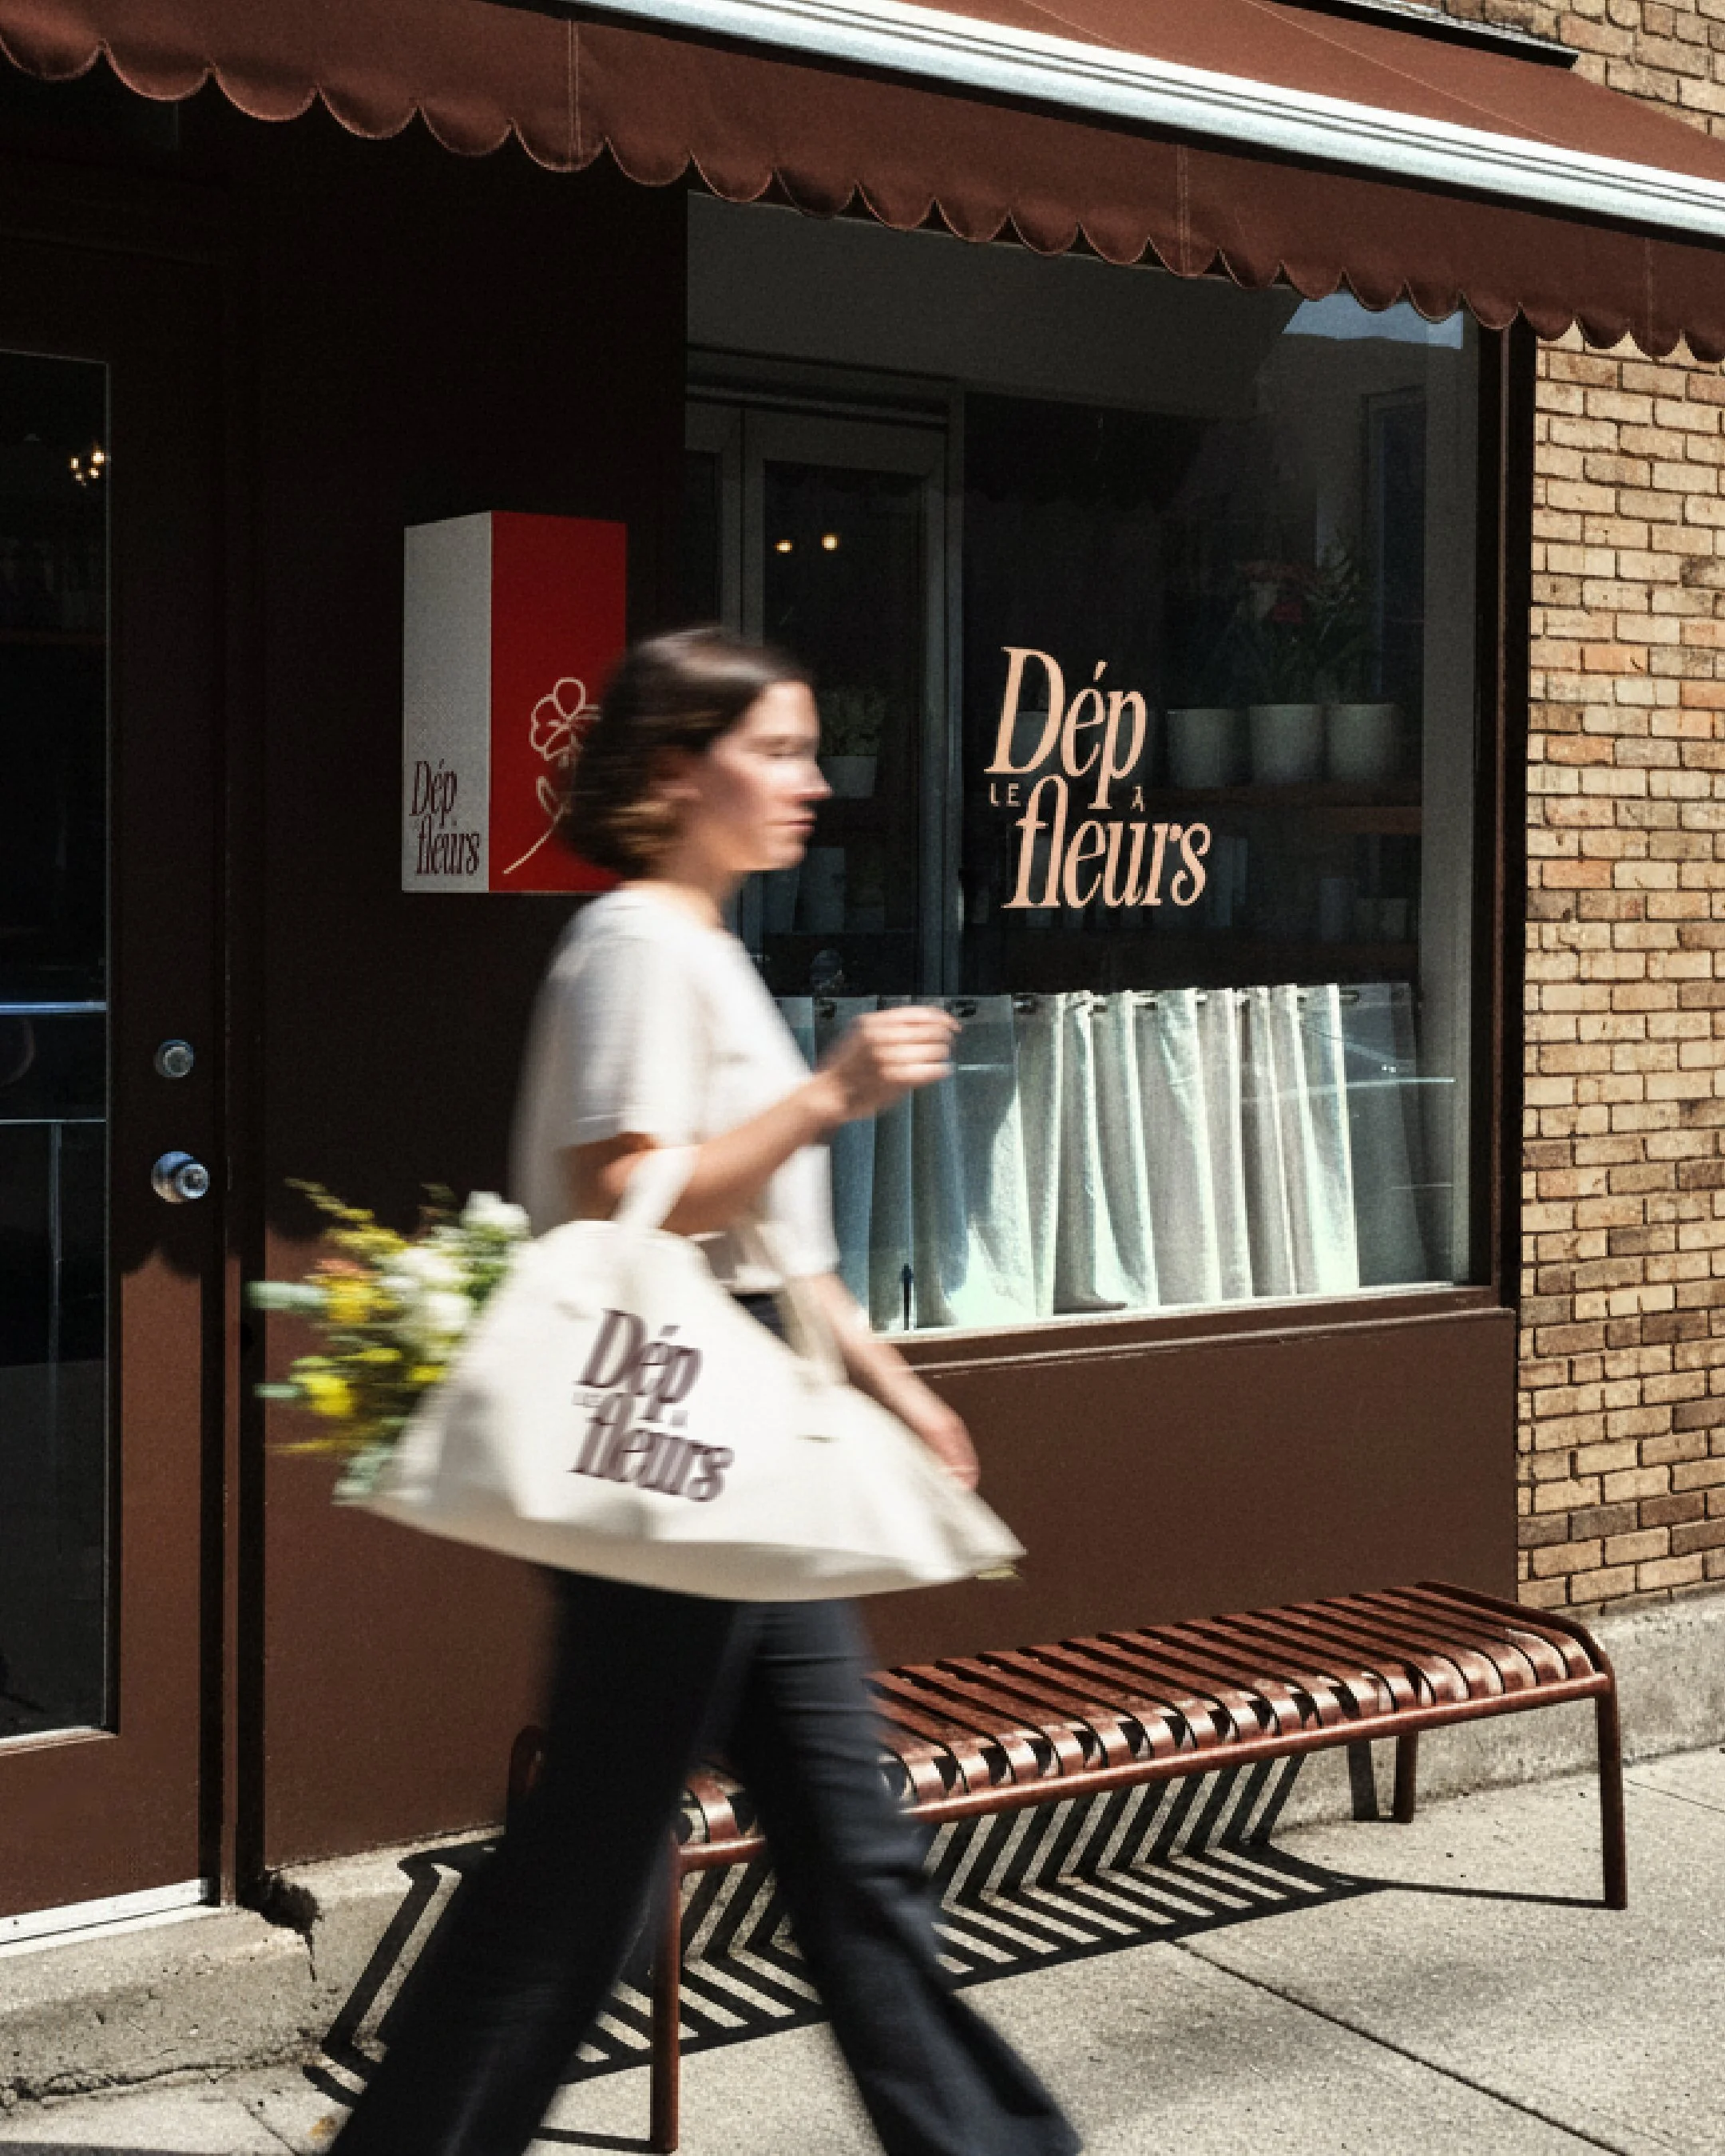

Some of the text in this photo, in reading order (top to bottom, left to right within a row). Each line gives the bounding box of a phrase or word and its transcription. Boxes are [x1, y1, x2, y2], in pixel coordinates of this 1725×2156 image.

[984, 646, 1148, 810] Dép
[408, 758, 458, 829] Dép
[414, 813, 481, 877] fleurs
[989, 783, 1021, 807] LE
[1000, 773, 1211, 910] fleurs
[571, 1308, 704, 1422] Dép
[565, 1392, 736, 1503] fleurs
